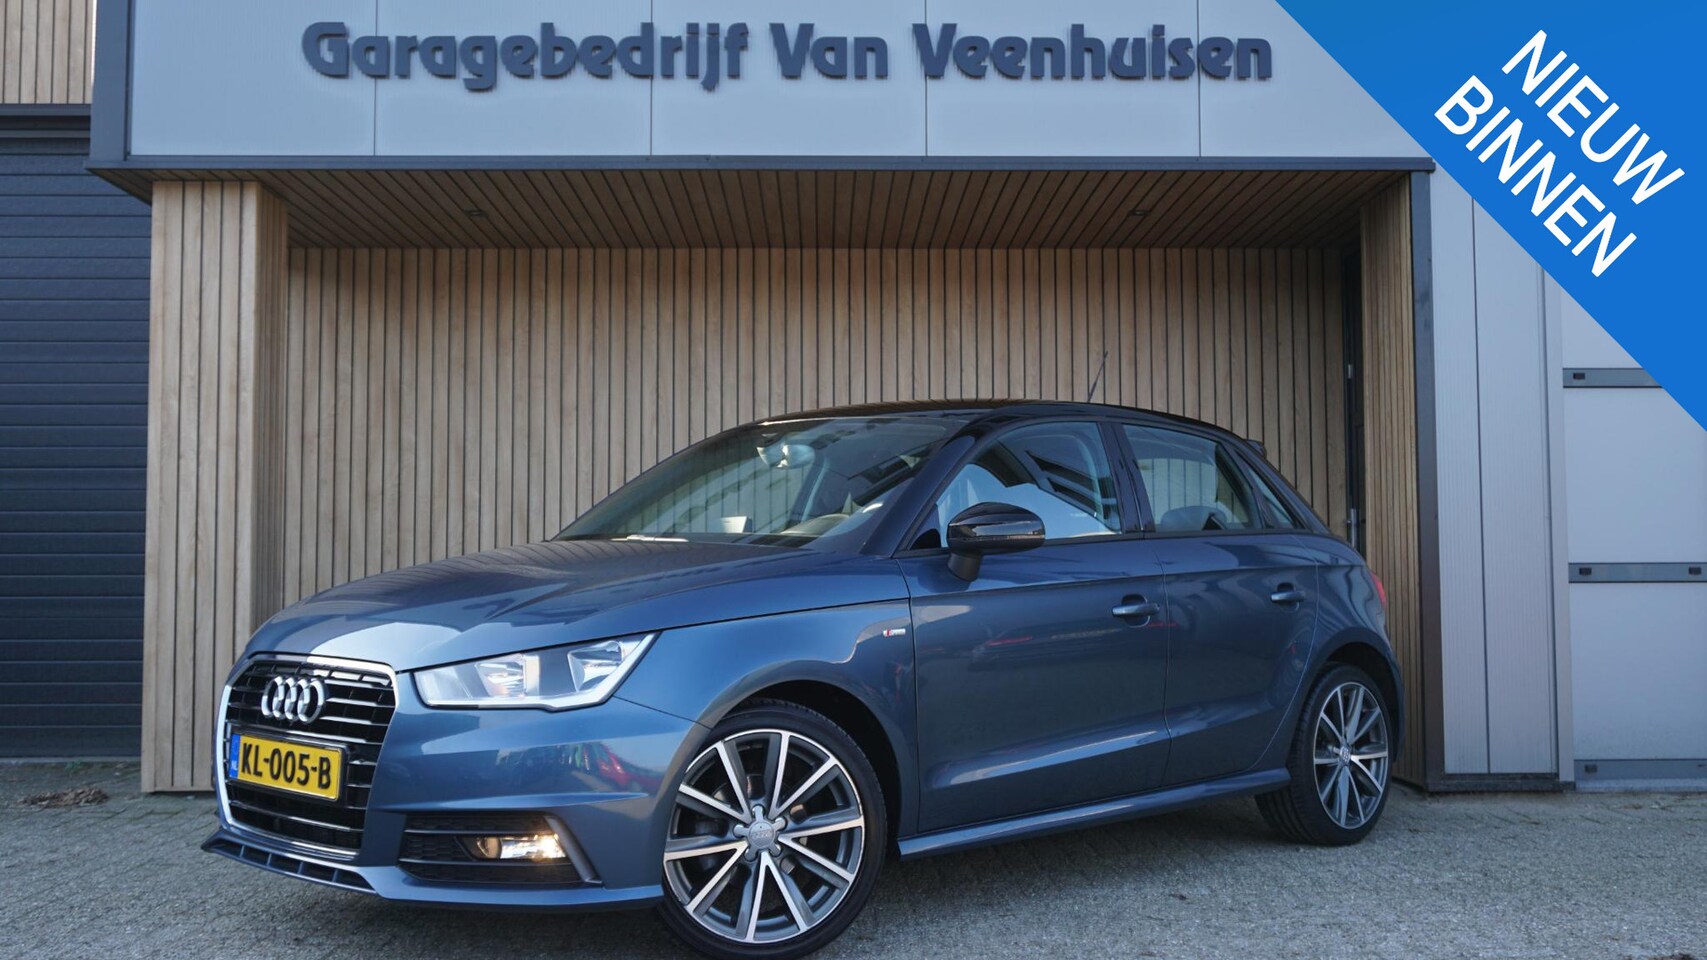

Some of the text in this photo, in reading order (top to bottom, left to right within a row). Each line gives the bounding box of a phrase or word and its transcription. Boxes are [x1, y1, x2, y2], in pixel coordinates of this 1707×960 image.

[302, 22, 1273, 92] Garagebedrijf Van Veenhuisen
[241, 742, 332, 790] KL-005-B
